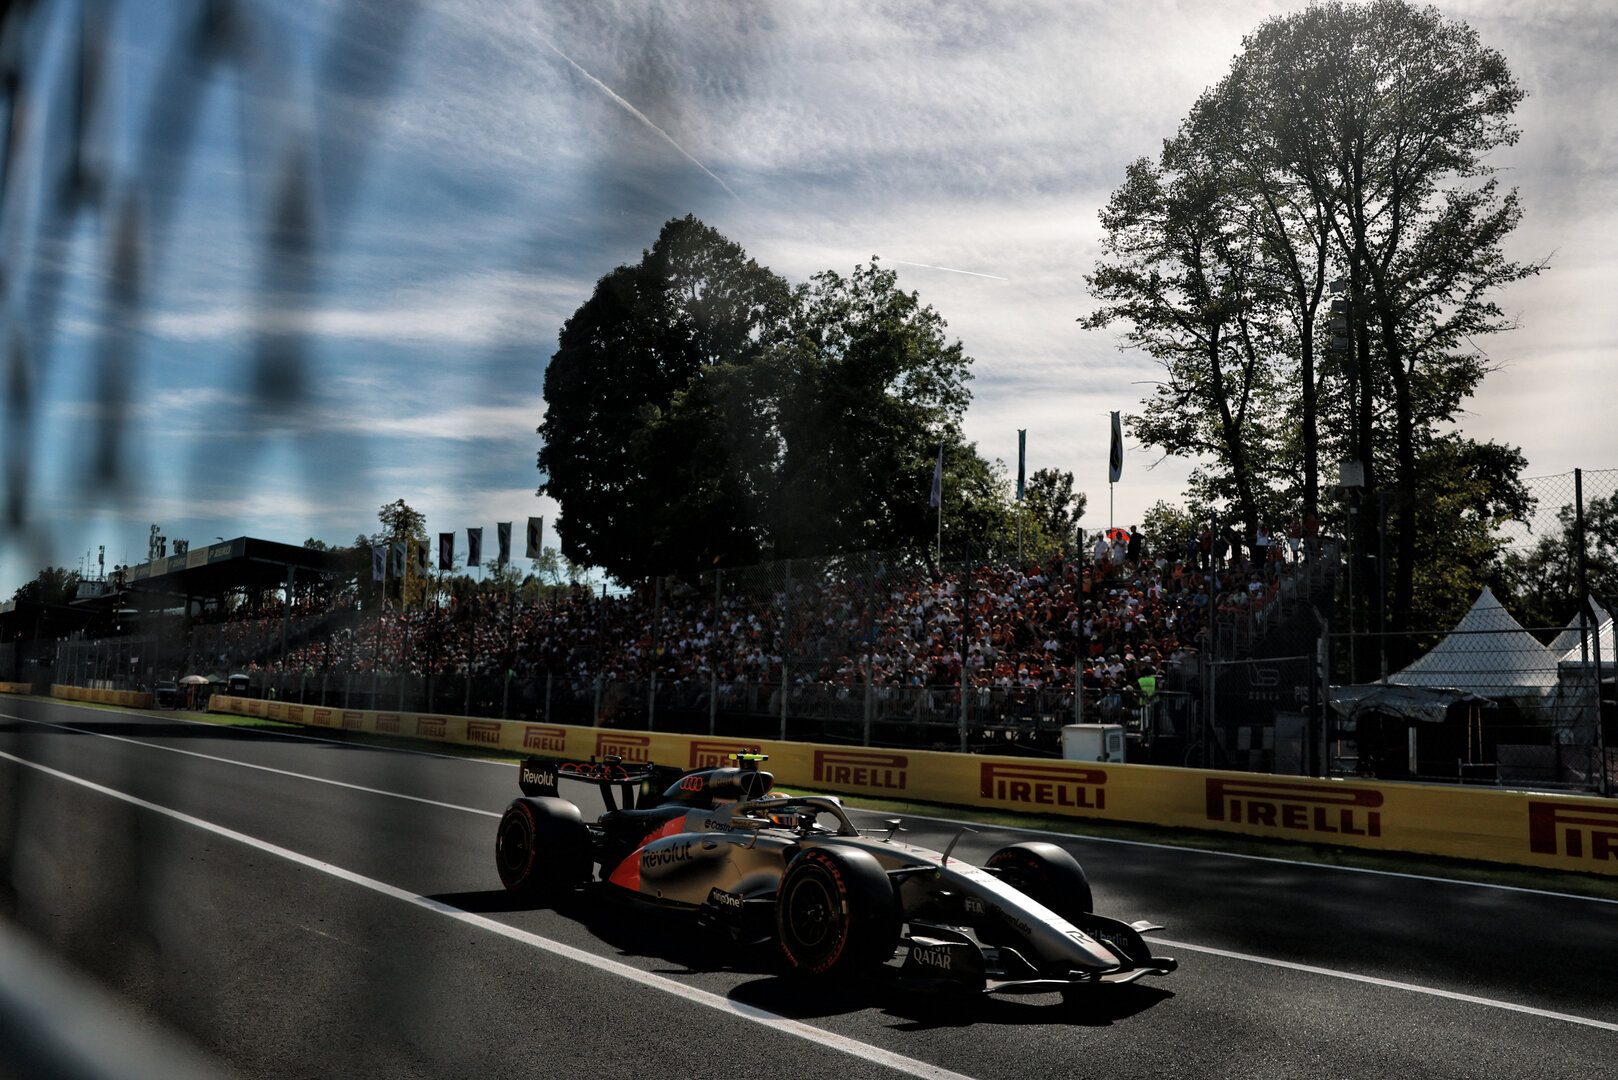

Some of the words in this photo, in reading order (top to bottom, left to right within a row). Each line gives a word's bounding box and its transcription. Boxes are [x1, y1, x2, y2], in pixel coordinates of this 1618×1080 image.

[467, 721, 501, 744] PIRELLI
[523, 726, 566, 752] PIRELLI
[596, 733, 649, 762] PIRELLI
[523, 768, 554, 787] Revolut
[813, 750, 908, 790] PIRELLI
[981, 762, 1107, 809] PIRELLI
[1206, 777, 1384, 837] PIRELLI
[643, 841, 693, 868] Revolut
[964, 900, 984, 914] FIA
[913, 946, 951, 970] QATAR
